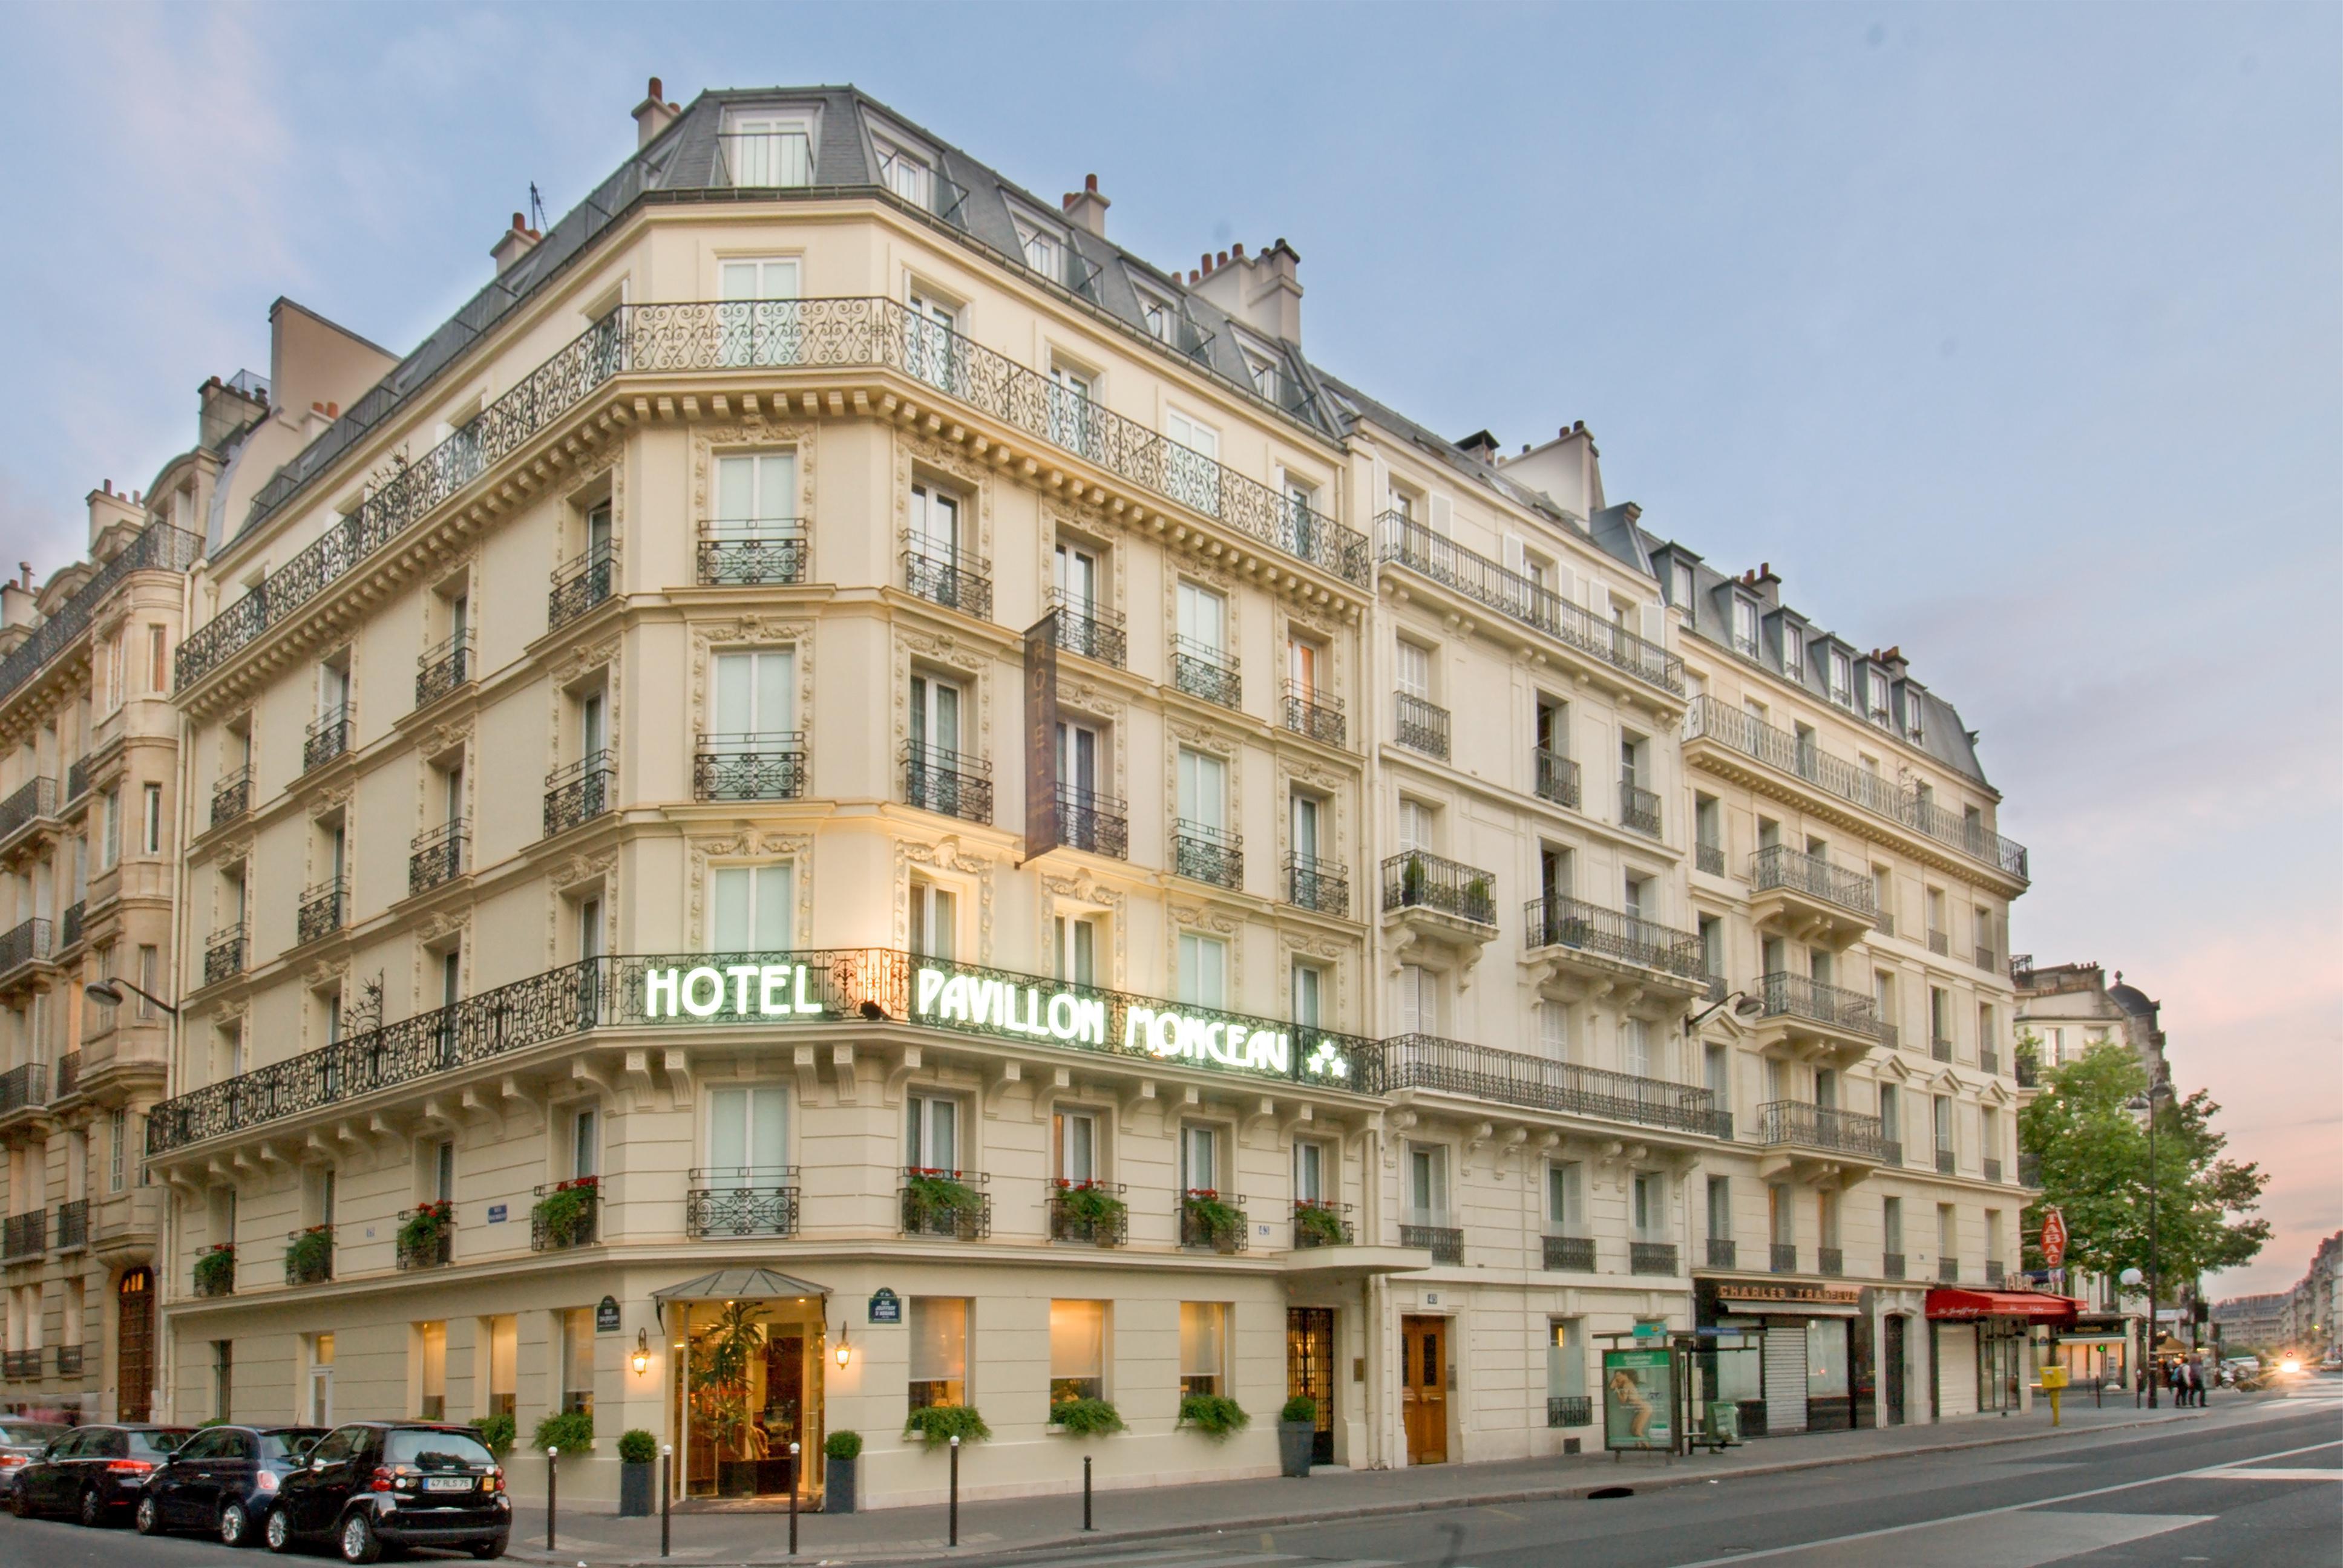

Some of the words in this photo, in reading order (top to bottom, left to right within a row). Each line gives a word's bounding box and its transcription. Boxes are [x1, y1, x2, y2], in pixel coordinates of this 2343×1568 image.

[646, 964, 822, 1018] HOTEL
[918, 968, 1105, 1045] PAVILLON
[1124, 1005, 1288, 1073] MONCEAU
[2043, 1214, 2061, 1264] TABAC
[1429, 1294, 1437, 1303] 45
[1720, 1285, 1786, 1298] CHARLES
[2004, 1275, 2034, 1292] TABAC
